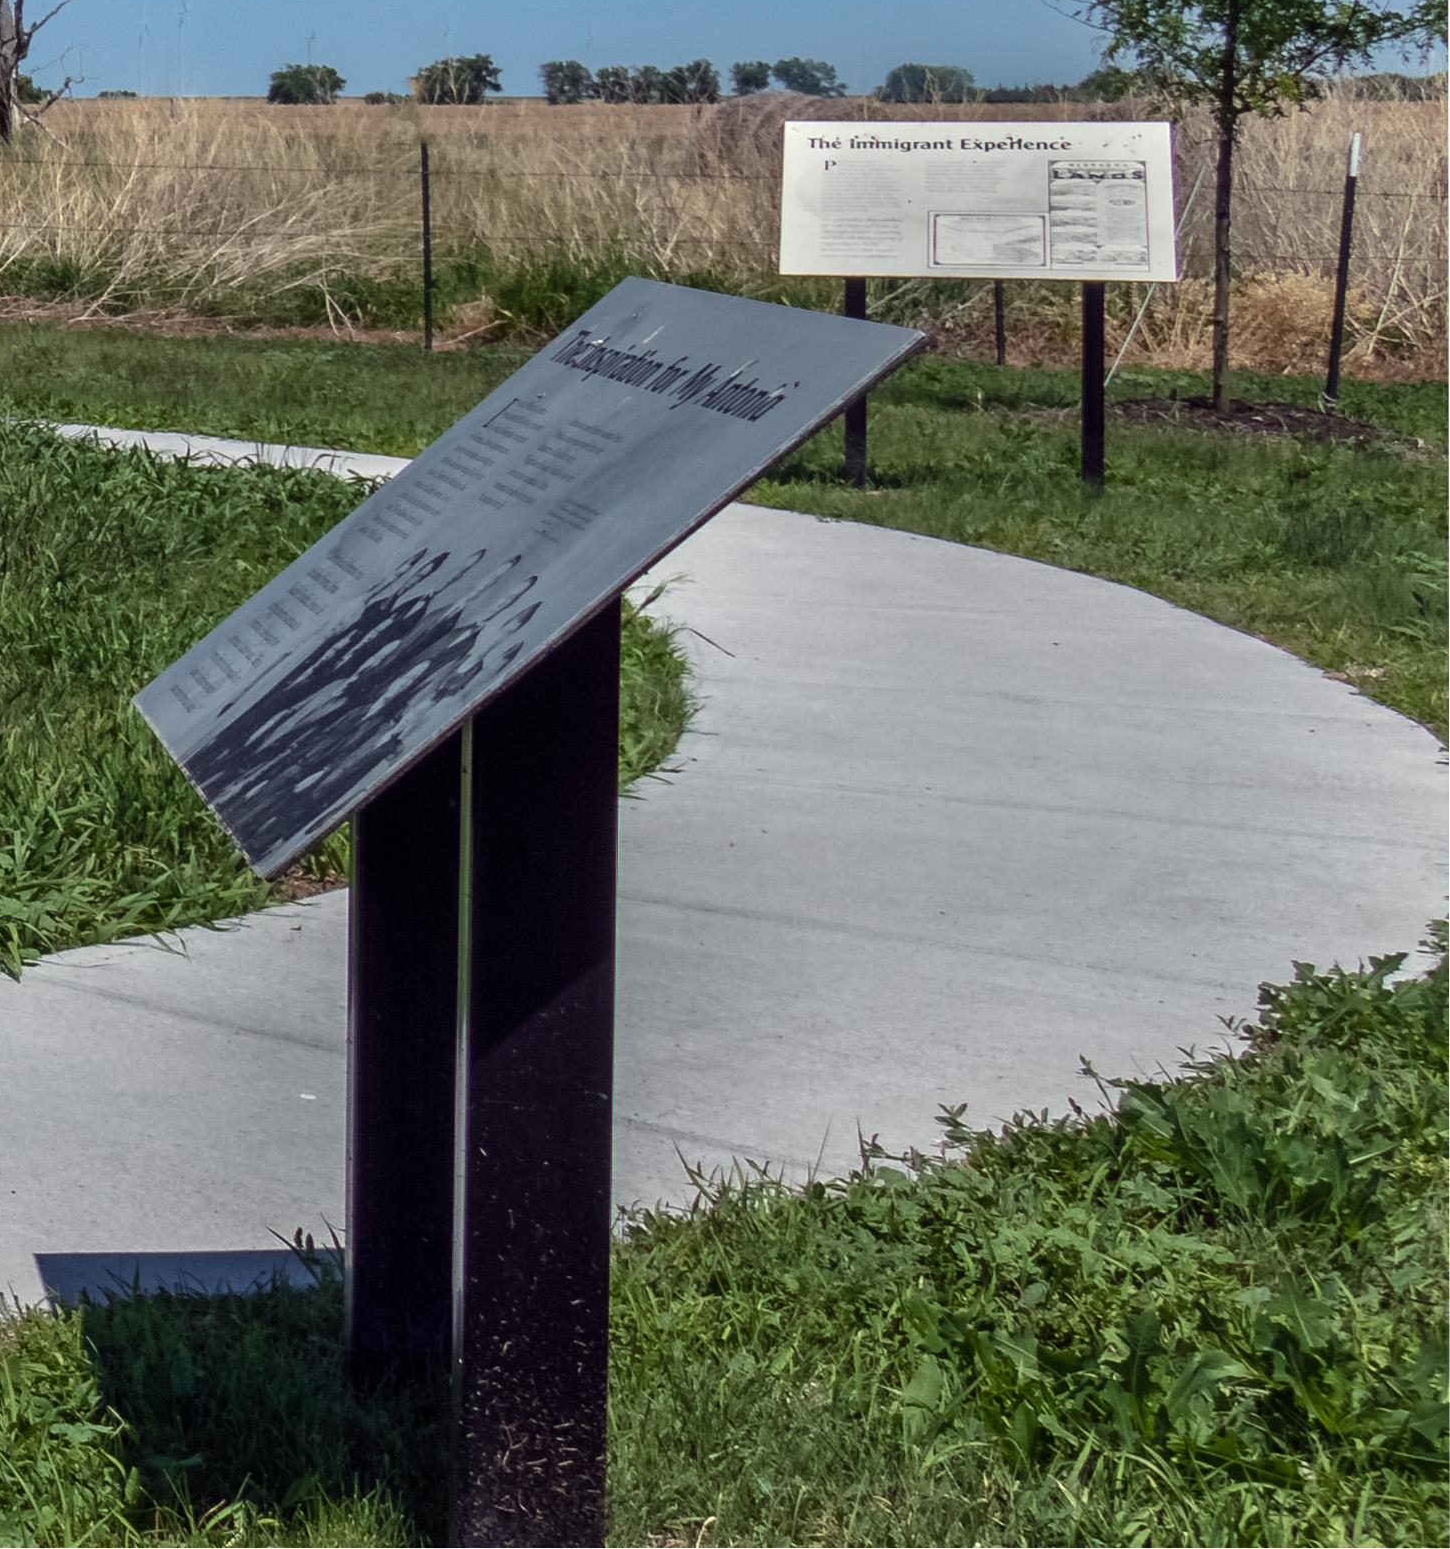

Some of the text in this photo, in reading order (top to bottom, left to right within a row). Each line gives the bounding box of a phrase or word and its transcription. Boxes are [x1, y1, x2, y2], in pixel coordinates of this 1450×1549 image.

[808, 137, 1072, 152] The Immigrant Experience
[1053, 170, 1143, 180] LANDS
[551, 330, 592, 365] The
[644, 356, 690, 394] for
[667, 363, 722, 410] My
